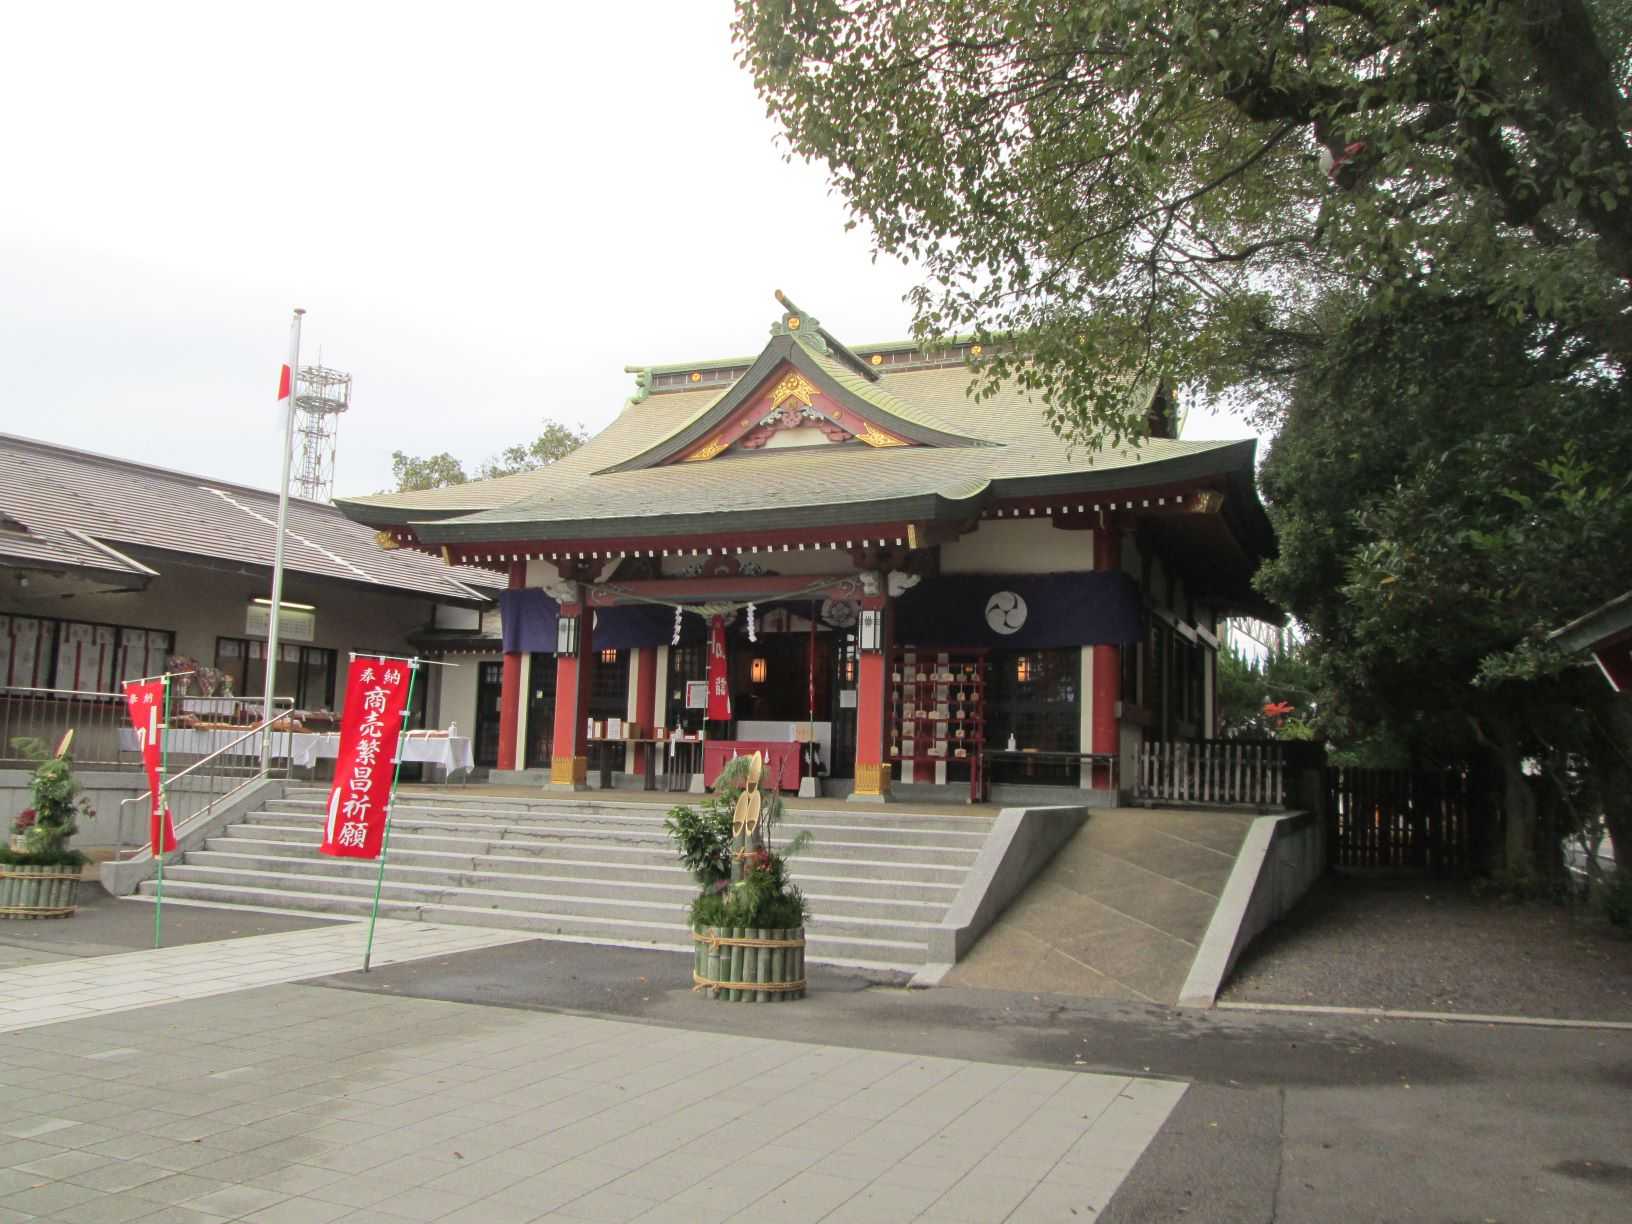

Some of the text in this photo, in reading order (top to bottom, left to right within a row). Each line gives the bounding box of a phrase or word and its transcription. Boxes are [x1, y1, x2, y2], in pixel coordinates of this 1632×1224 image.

[360, 667, 401, 685] 奉納
[339, 686, 391, 848] 商売繁昌祈願
